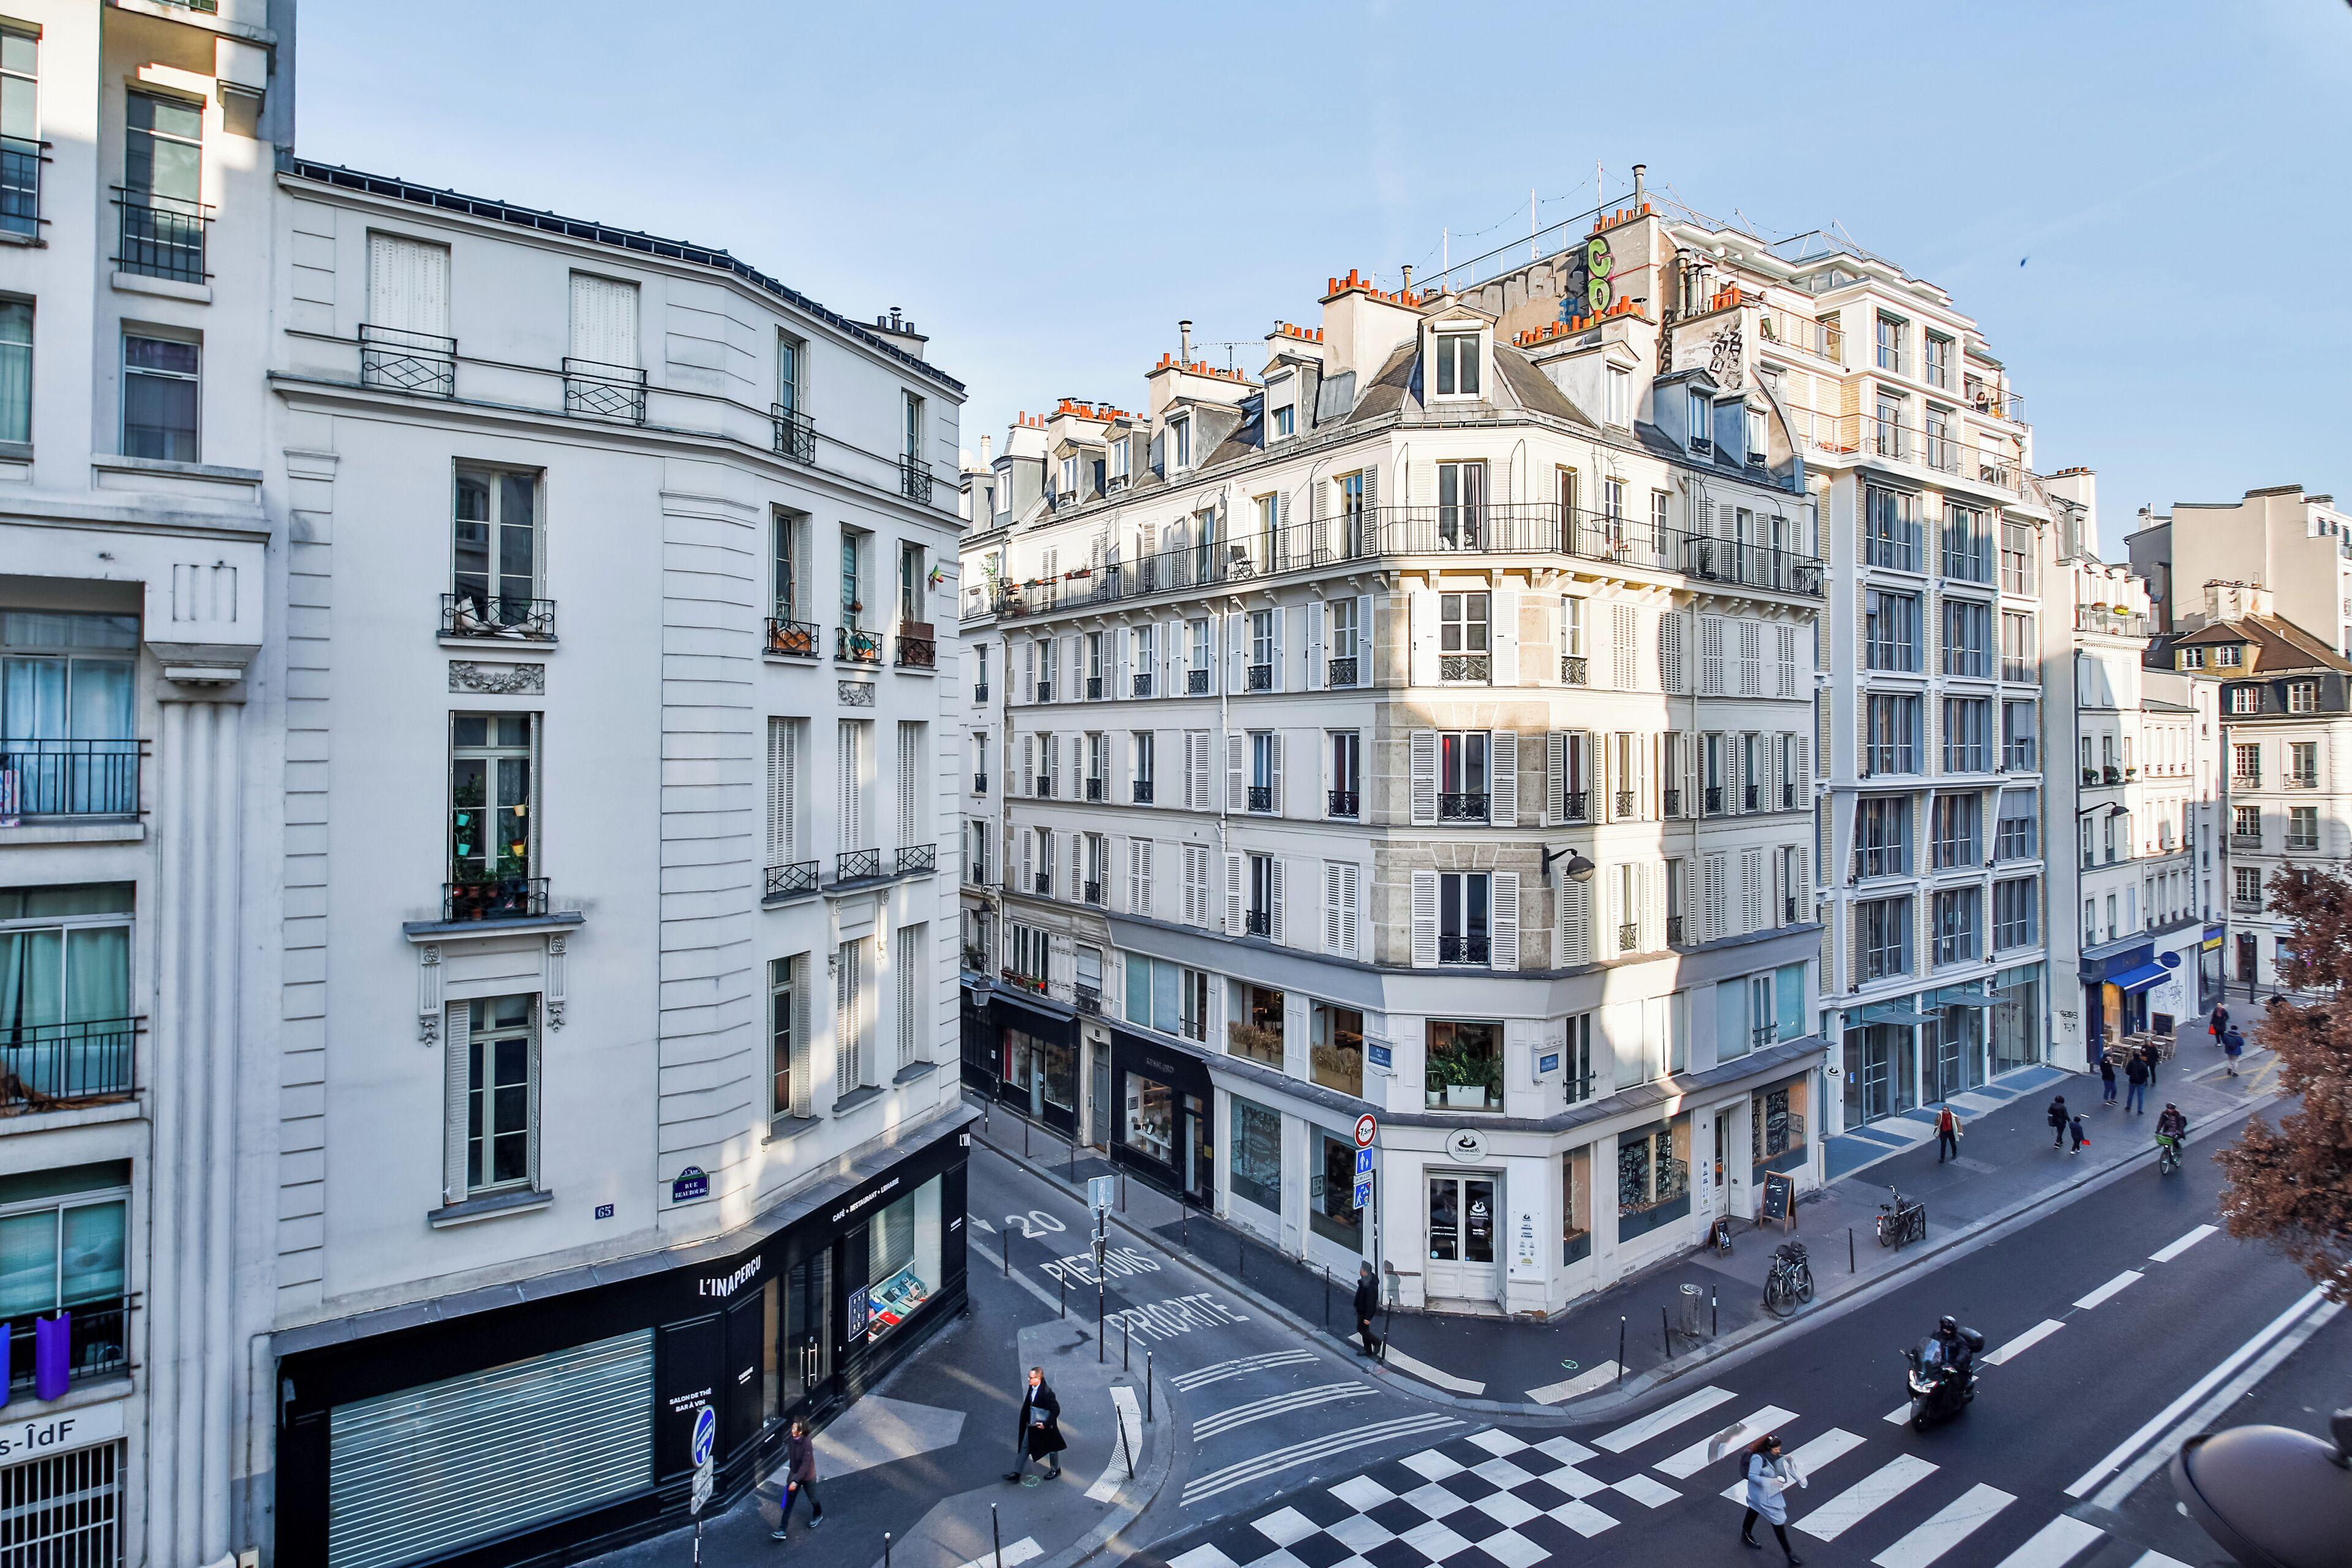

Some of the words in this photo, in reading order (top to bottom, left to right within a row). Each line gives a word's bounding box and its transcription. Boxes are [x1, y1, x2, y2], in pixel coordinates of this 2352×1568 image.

[675, 1187, 707, 1199] BEAUBOURG
[850, 1190, 878, 1213] RESTAURANT
[597, 1205, 611, 1218] 65
[1005, 1210, 1066, 1239] 20
[699, 1254, 761, 1297] L'INAPERÇU
[1103, 1292, 1251, 1346] PRIORITE
[669, 1394, 690, 1405] SALON
[676, 1404, 688, 1412] BAR
